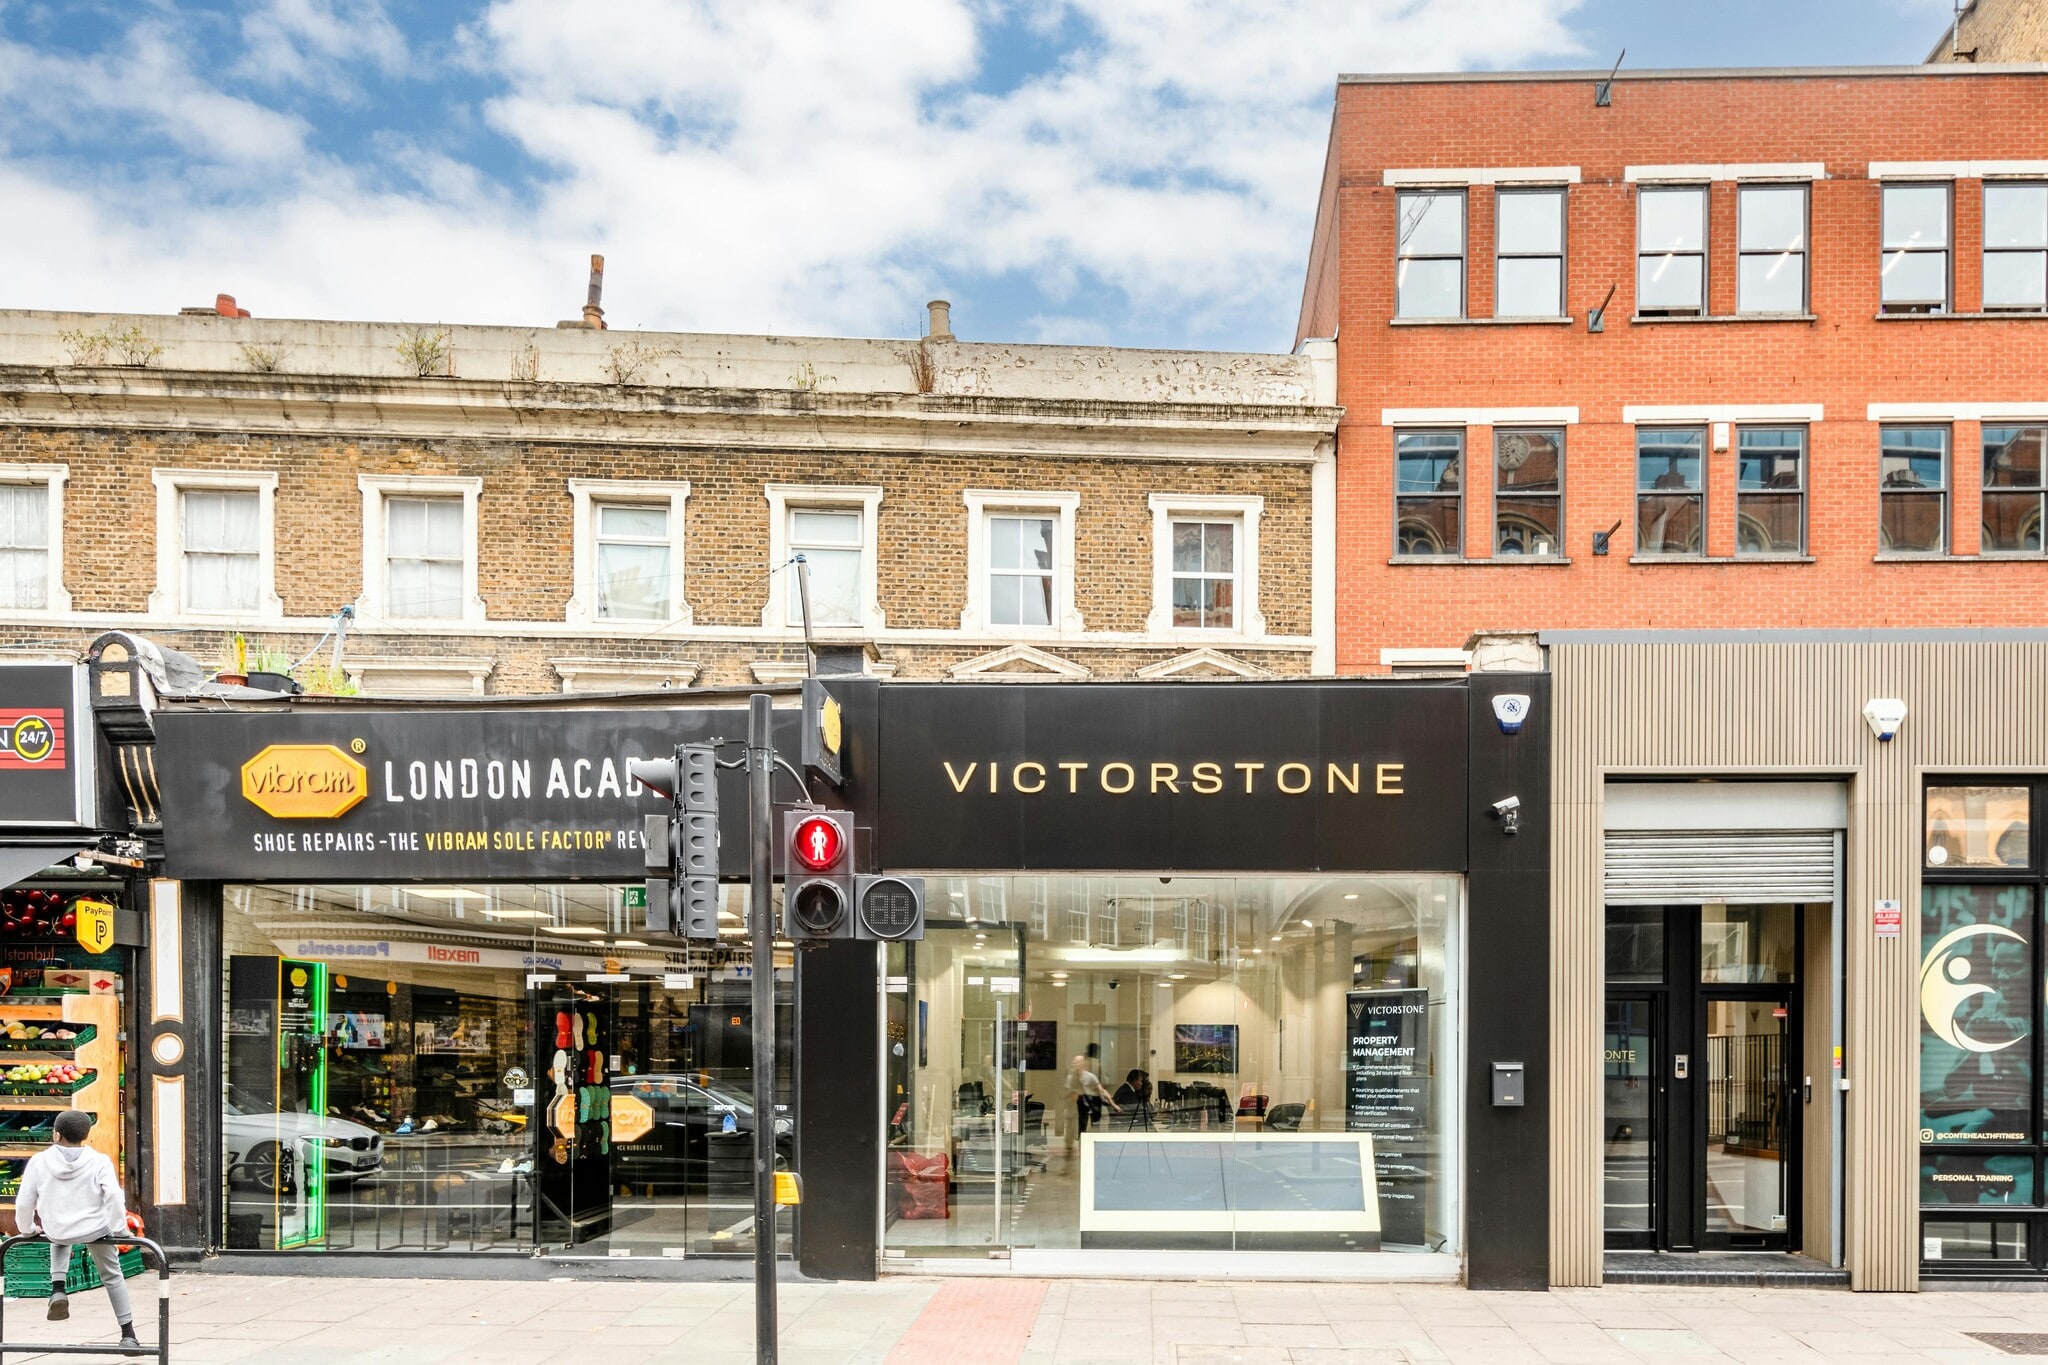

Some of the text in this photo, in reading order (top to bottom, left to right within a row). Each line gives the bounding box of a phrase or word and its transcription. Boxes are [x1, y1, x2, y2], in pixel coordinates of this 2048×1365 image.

[20, 731, 48, 745] 24/7
[251, 764, 356, 794] vibram
[384, 757, 665, 802] LONDON ACAD
[943, 761, 1405, 795] VICTORSTONE
[253, 833, 297, 852] SHOE
[303, 832, 375, 852] REPAIRS
[425, 831, 489, 851] VIBRAM
[493, 831, 536, 851] SOLE
[84, 905, 112, 918] PayPoint
[4, 945, 55, 961] Istanbul
[701, 950, 753, 965] REPAIRS
[1368, 1005, 1424, 1014] VICTORSTONE
[1353, 1035, 1398, 1045] PROPERTY
[1353, 1047, 1415, 1056] MANAGEMENT
[1604, 1050, 1636, 1060] ONTE
[1936, 1132, 2025, 1140] @CONTEHEALTHFITNESS
[1932, 1174, 2014, 1182] PERSONAL TRAINING
